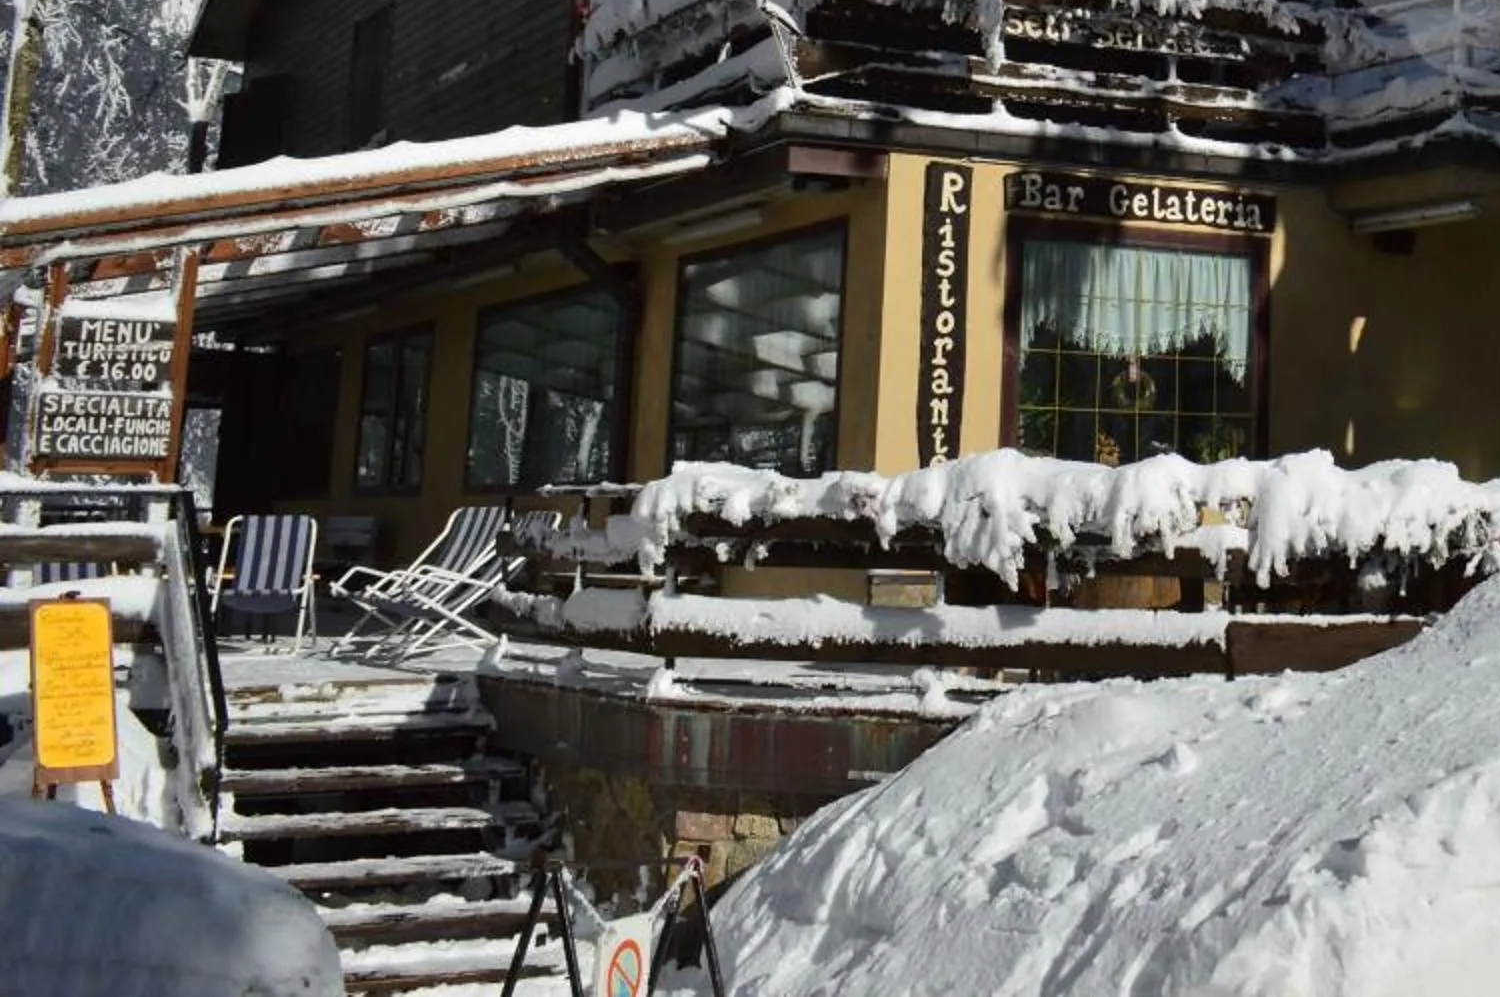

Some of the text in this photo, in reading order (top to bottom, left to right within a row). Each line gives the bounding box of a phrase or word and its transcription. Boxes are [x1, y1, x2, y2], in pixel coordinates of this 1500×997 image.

[1020, 174, 1263, 231] Bar Gelateria
[63, 341, 173, 363] TURISTICO
[100, 362, 157, 382] 16.00
[40, 434, 169, 457] E CACCIAGIONE
